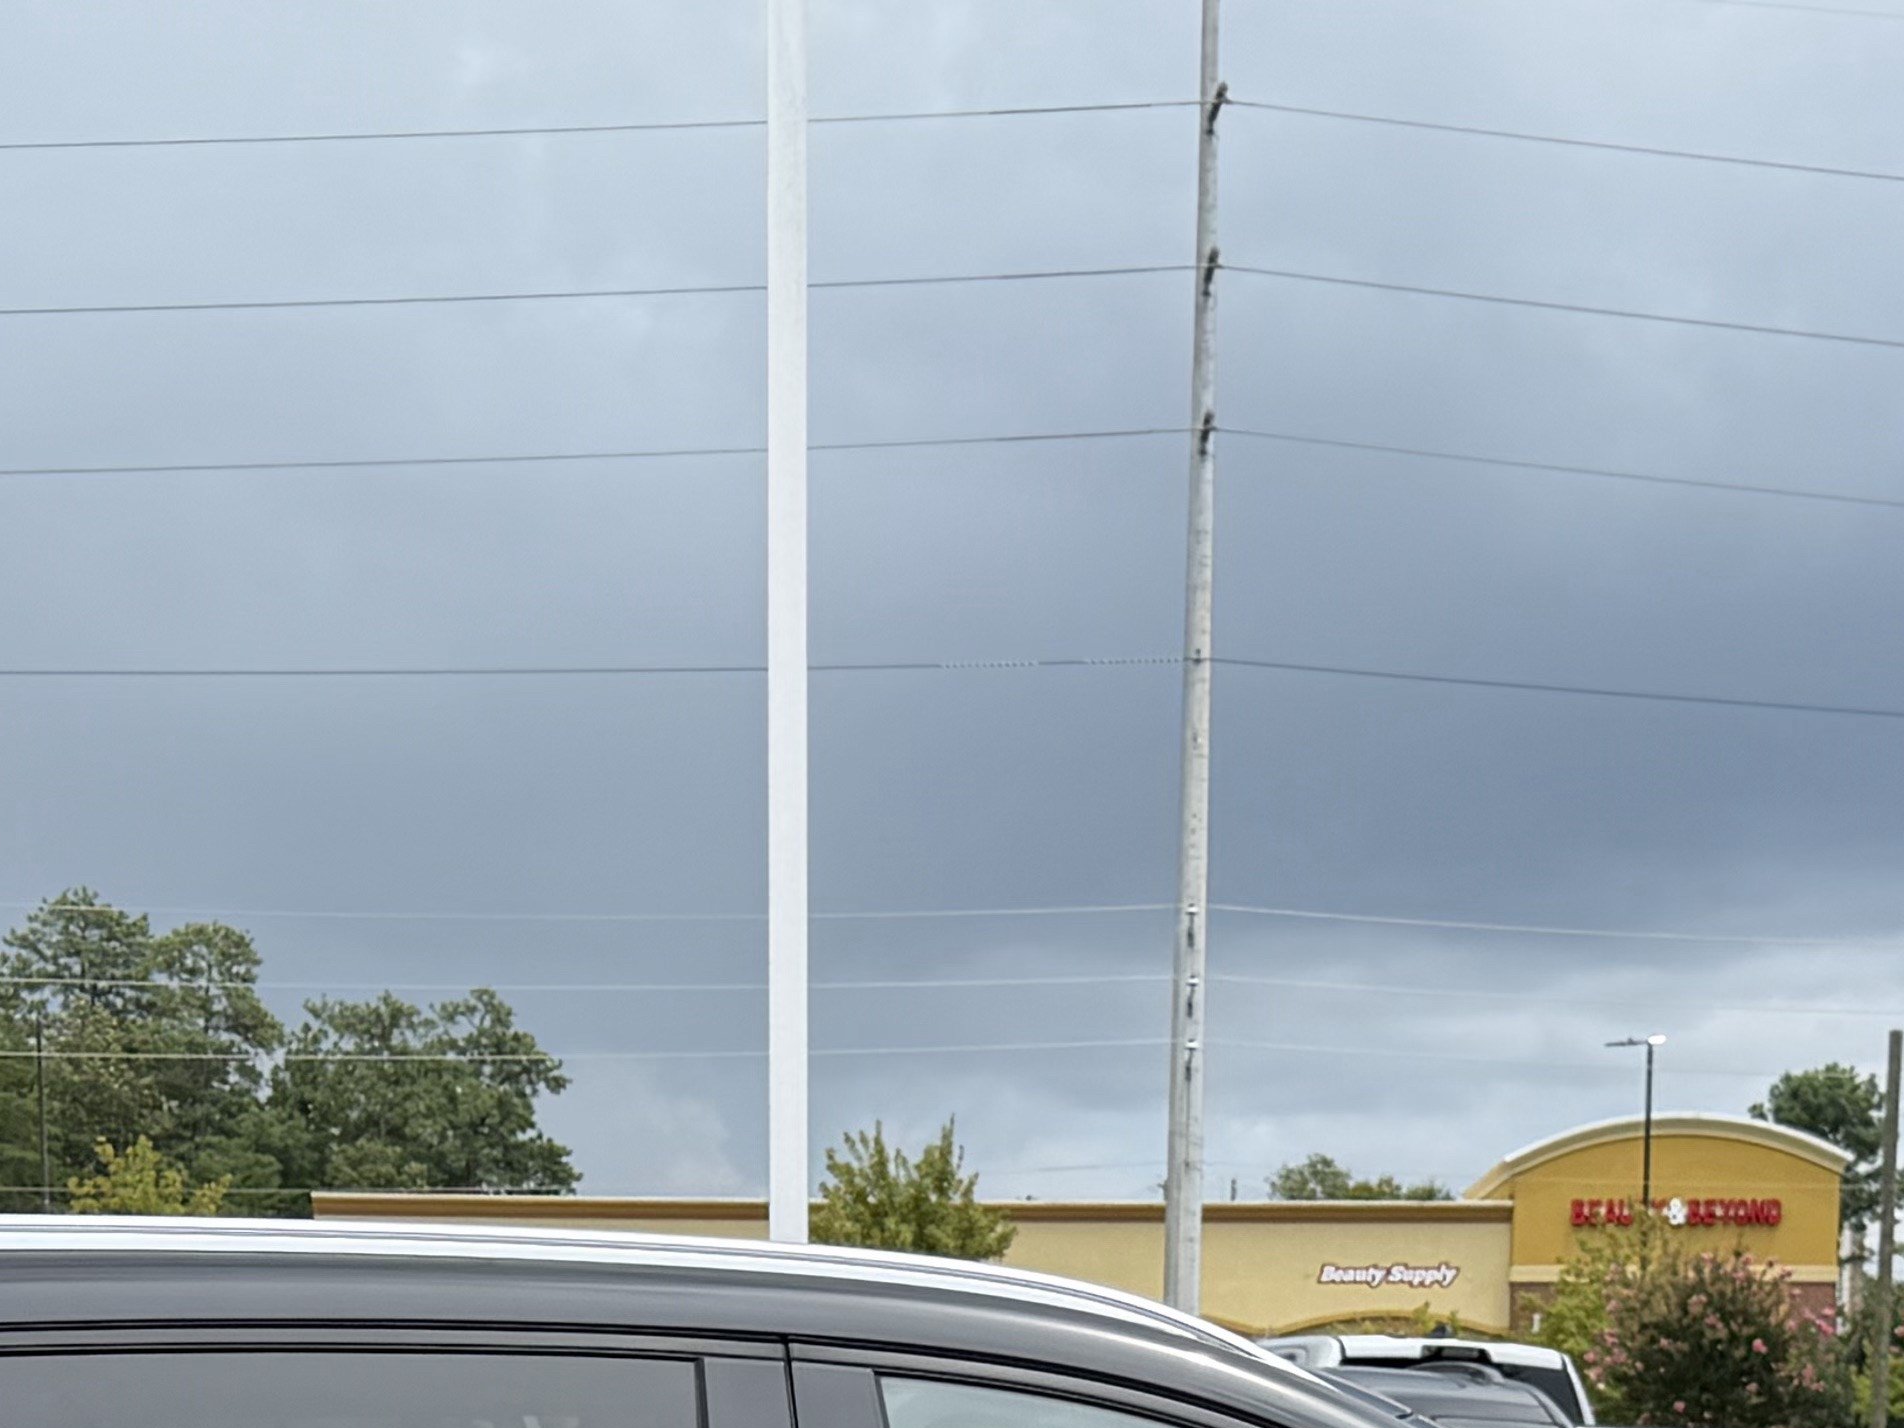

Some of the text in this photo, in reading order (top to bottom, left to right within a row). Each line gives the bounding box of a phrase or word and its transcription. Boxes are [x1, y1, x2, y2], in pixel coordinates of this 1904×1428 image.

[1571, 1198, 1669, 1226] BEAU
[1688, 1199, 1782, 1226] BEYOND
[1319, 1263, 1459, 1287] Beauty Supply
